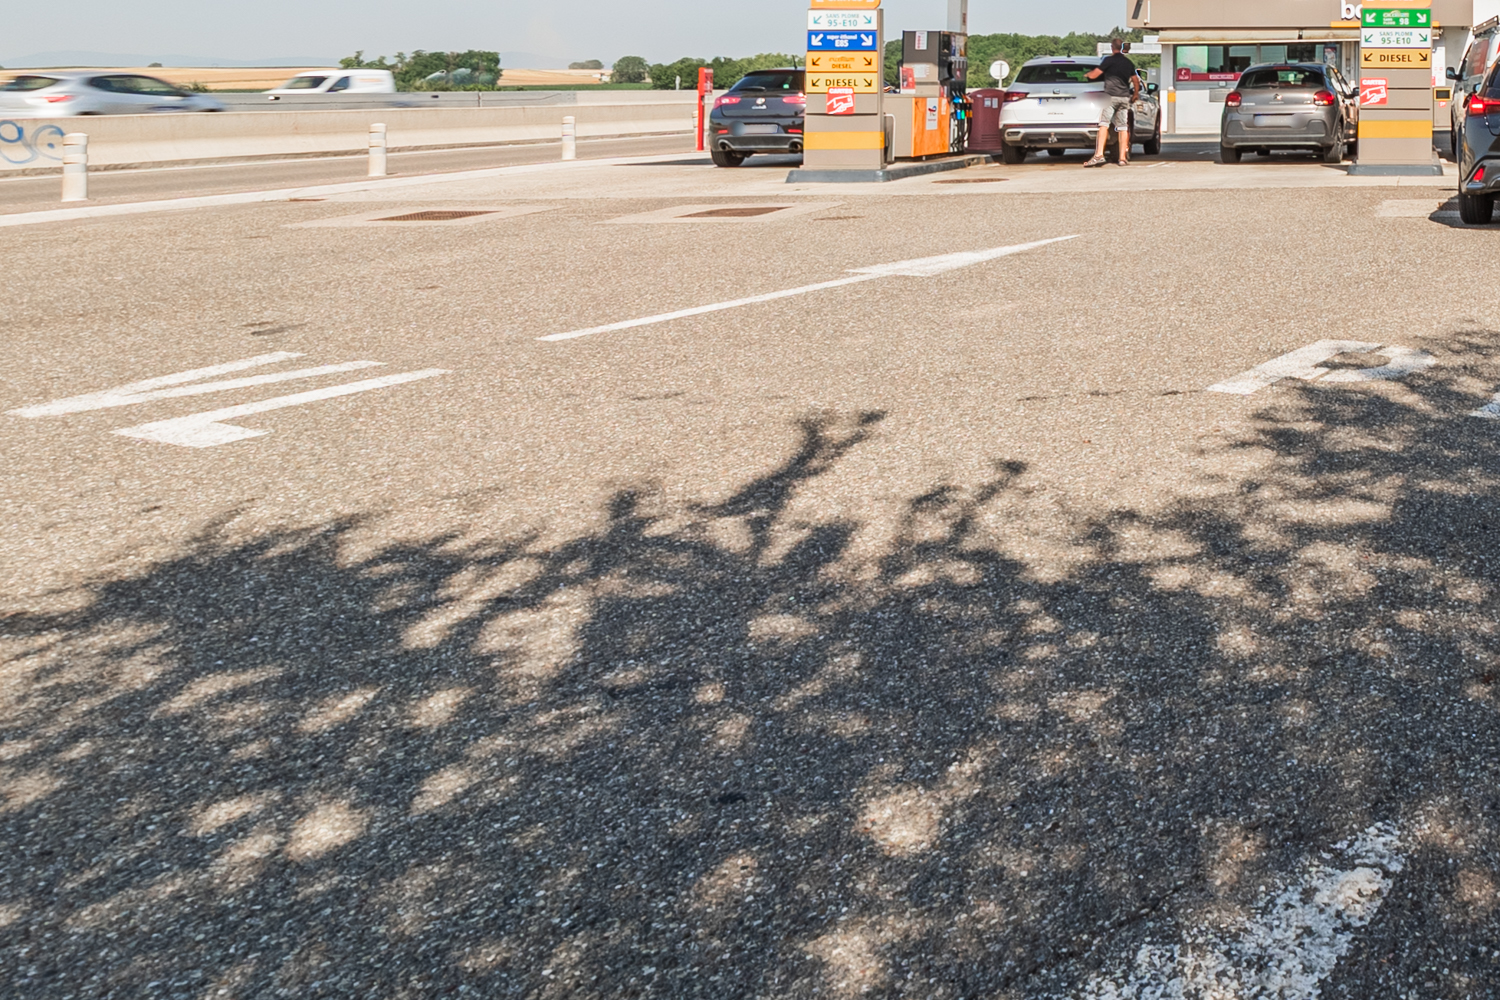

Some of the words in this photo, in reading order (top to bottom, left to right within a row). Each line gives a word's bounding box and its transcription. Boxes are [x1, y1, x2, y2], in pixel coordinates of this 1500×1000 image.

[827, 19, 858, 27] 95-E10
[1399, 17, 1410, 25] 98
[1380, 36, 1412, 45] 95-E10
[1379, 54, 1413, 63] DIESEL
[825, 78, 858, 87] DIESEL
